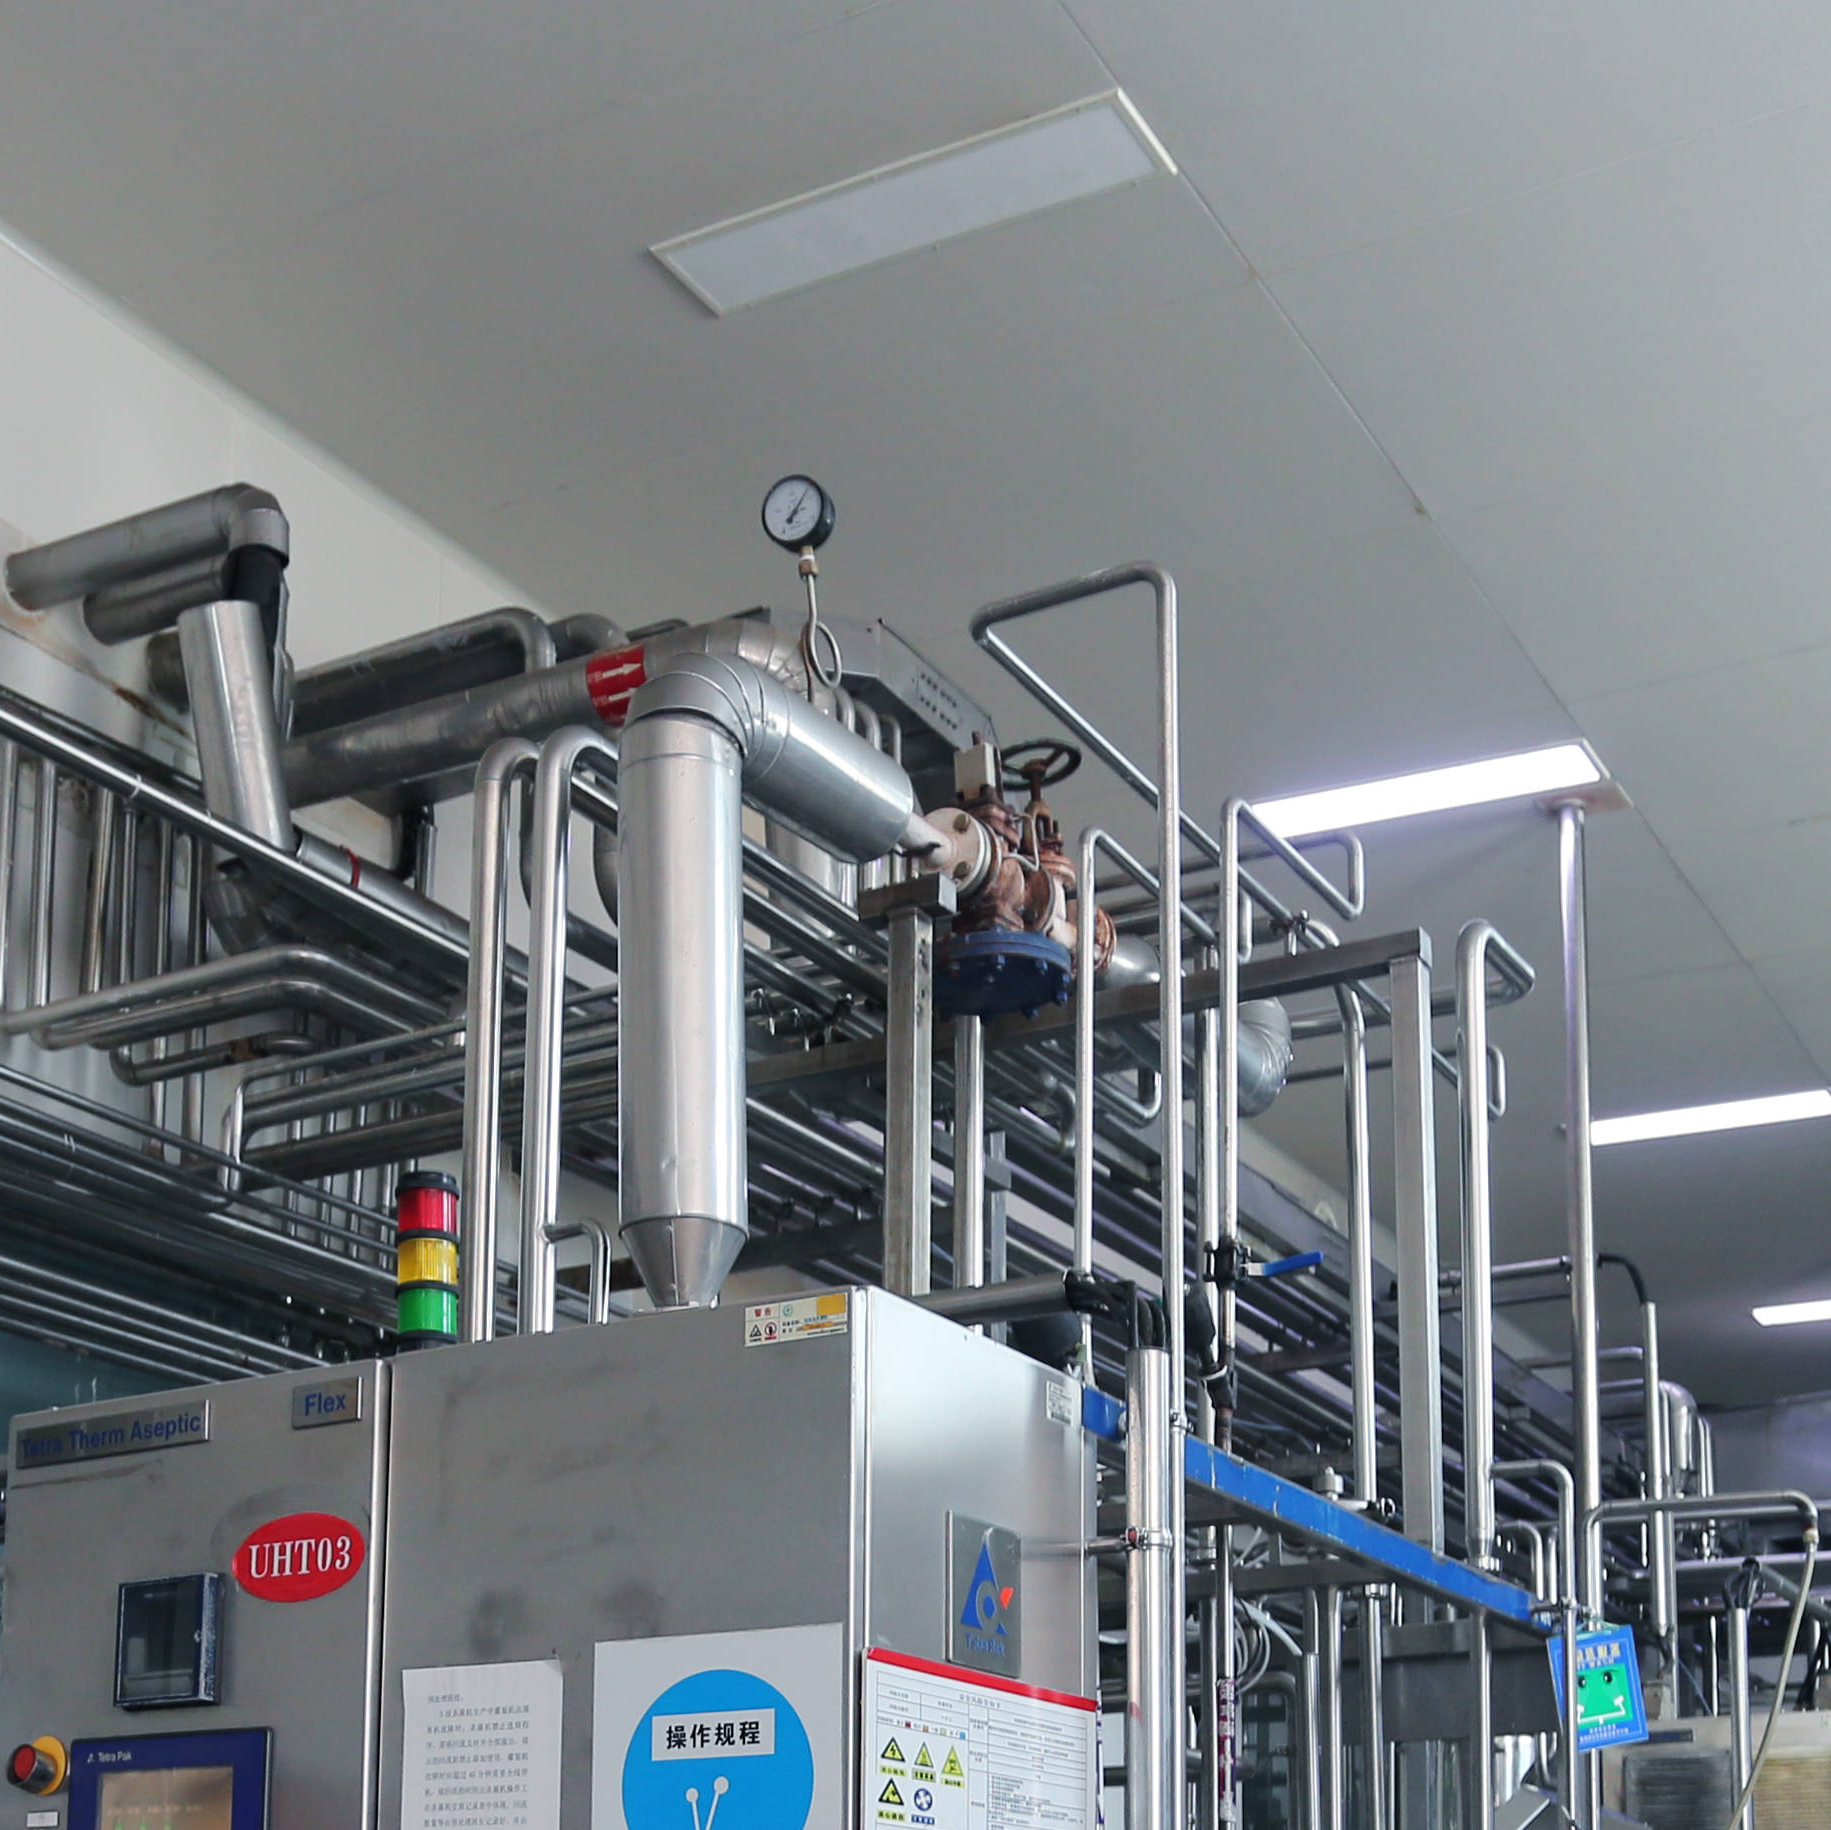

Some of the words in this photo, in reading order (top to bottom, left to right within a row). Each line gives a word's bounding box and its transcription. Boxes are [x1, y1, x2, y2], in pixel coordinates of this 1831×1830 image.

[304, 1392, 347, 1417] Flex
[20, 1436, 63, 1458] Tetra
[70, 1427, 125, 1450] Therm
[130, 1412, 201, 1443] Aseptic
[249, 1535, 352, 1579] UHT03
[666, 1720, 761, 1750] 操作规程
[117, 1751, 132, 1761] Pak
